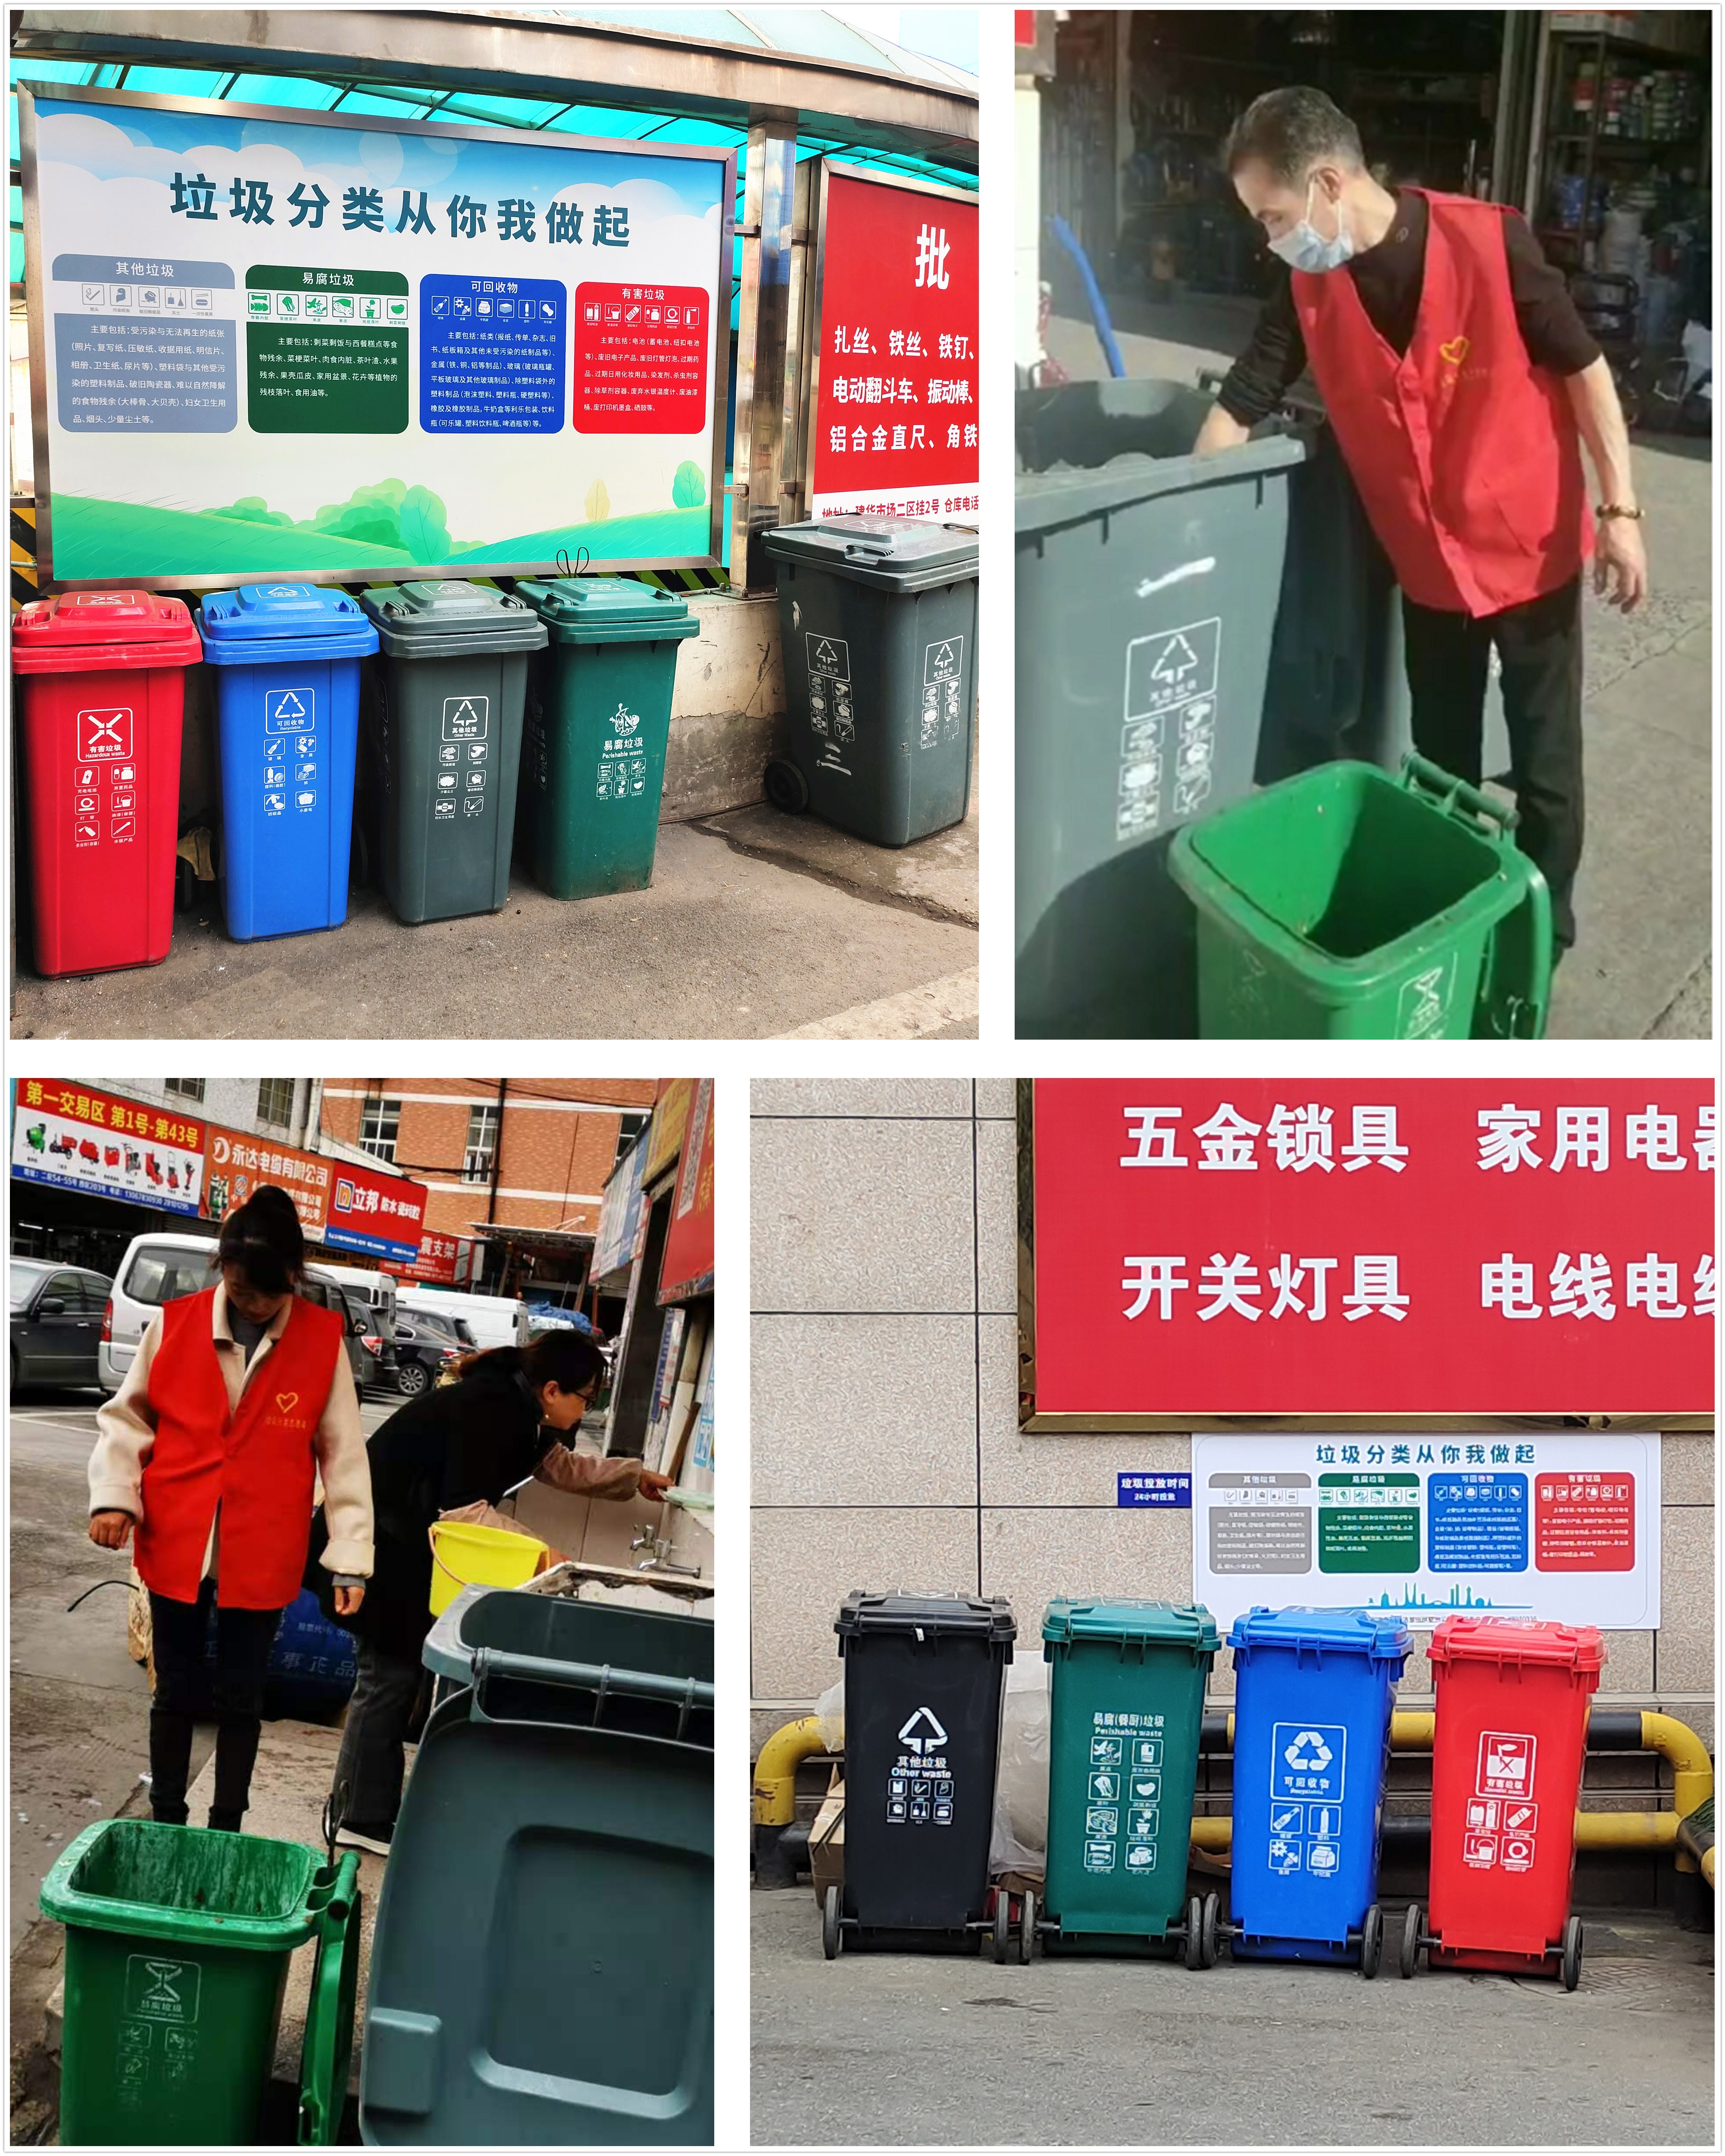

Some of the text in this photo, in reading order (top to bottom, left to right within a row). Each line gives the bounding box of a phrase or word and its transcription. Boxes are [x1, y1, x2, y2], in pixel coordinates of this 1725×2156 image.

[170, 172, 630, 247] 垃圾分类从你我做起
[914, 223, 951, 290] 批
[116, 262, 174, 278] 其他垃圾
[302, 272, 354, 287] 易腐垃圾
[471, 281, 518, 294] 可回收物
[622, 287, 665, 300] 有害垃圾
[91, 325, 225, 338] 主要包括：受污染与无法再生的纸张
[278, 337, 397, 349] 主要包括：剩菜剩饭与西餐糕点等食
[600, 337, 700, 347] 主要包括：电池（蓄电池、纽扣电池
[72, 342, 225, 355] （照片、复写纸、压敏纸、收据用纸、明信片、
[259, 353, 397, 365] 物残余、菜梗菜叶、肉食内脏、茶叶渣、水果
[584, 353, 699, 363] 等）、废旧电子产品、废旧灯管灯泡、过期药
[71, 361, 225, 372] 相册、卫生纸、尿片等）、塑料袋与其他受污
[259, 371, 397, 381] 残余、果壳瓜皮、家用盆景、花卉等植物的
[584, 370, 698, 380] 品、过期日用化妆用品、染发剂、杀虫剂容
[72, 378, 225, 390] 染的塑料制品、破旧陶瓷器、难以自然降解
[259, 388, 328, 397] 残枝落叶、食用油等。
[584, 387, 698, 396] 器、除草剂容器、废弃水银温度计、废油漆
[72, 397, 225, 407] 的食物残余（大棒骨、大贝壳）、妇女卫生用
[584, 403, 656, 412] 桶、废打印机墨盒、硒鼓等。
[73, 415, 154, 424] 品、烟头、少量尘土等。
[944, 495, 979, 513] 仓库电话
[816, 663, 839, 673] 其他垃圾
[933, 667, 953, 678] 其他垃圾
[276, 719, 304, 727] 可回收物
[89, 744, 121, 753] 有害垃圾
[603, 737, 643, 751] 易腐垃圾
[602, 750, 628, 759] Perishable
[26, 1081, 198, 1148] 第一交易区 第1号-第43号
[1119, 1102, 1409, 1176] 五金锁具
[419, 1236, 455, 1259] 震支架
[1120, 1252, 1411, 1324] 开关灯具
[1316, 1444, 1536, 1465] 垃圾分类从你我做起
[897, 1756, 947, 1769] 其他垃圾
[891, 1767, 920, 1778] Other
